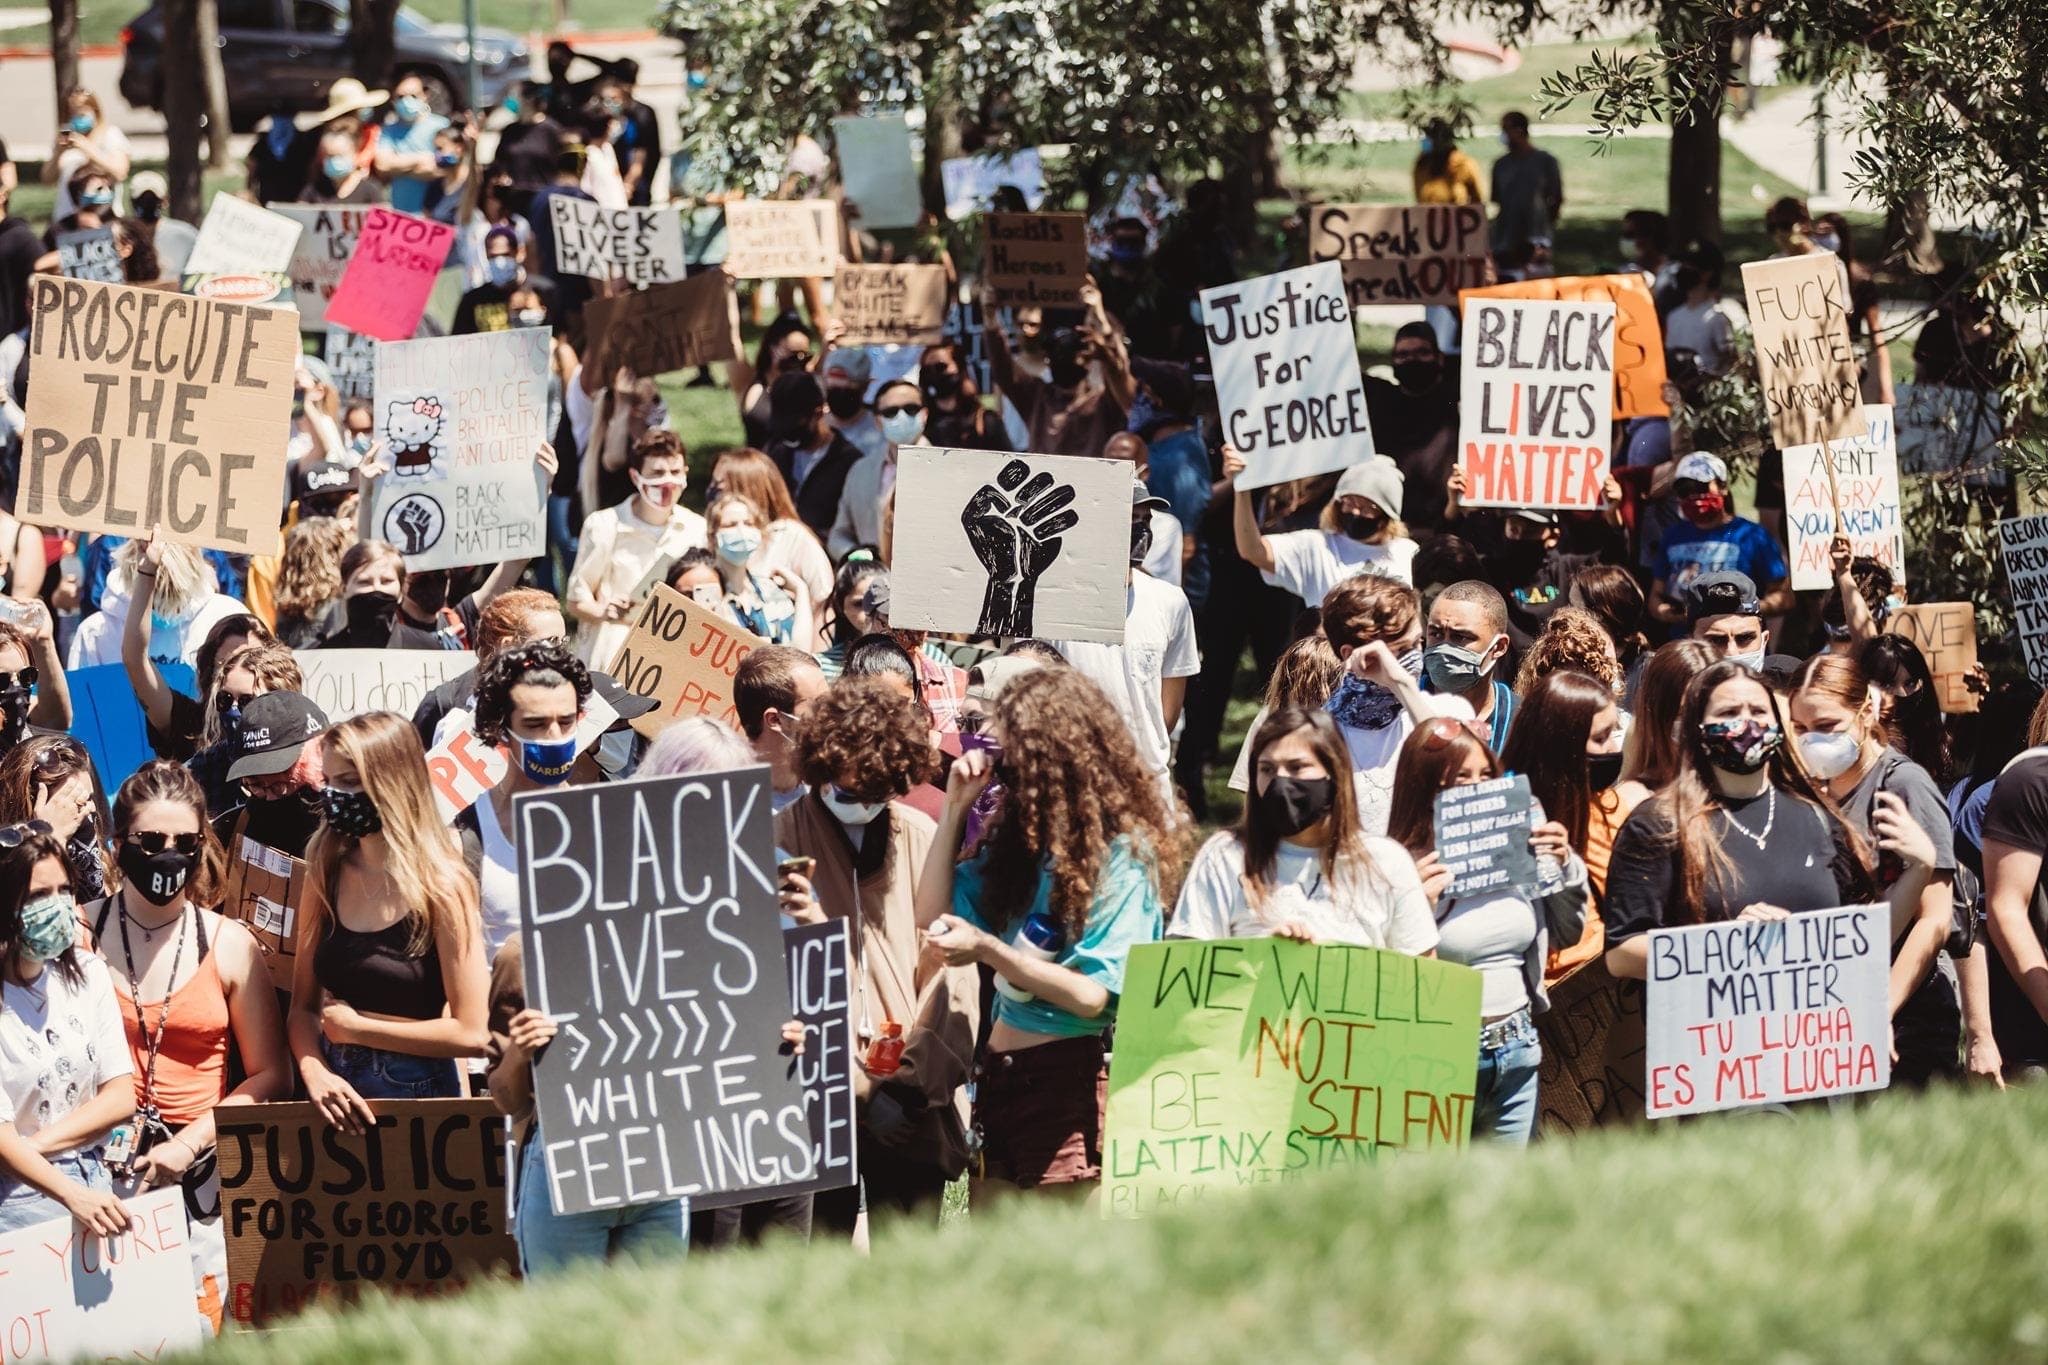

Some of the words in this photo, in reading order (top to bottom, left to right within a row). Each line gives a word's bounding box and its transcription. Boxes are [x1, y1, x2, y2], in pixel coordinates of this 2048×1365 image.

[368, 207, 447, 247] STOP
[555, 200, 657, 233] BLACK
[1314, 207, 1421, 262] Speak
[1425, 206, 1482, 253] UP
[559, 228, 650, 258] LIVES
[562, 250, 669, 279] MATTER
[1206, 281, 1349, 346] Justice
[1756, 274, 1845, 323] FUCK
[34, 279, 273, 389] PROSECUTE
[1476, 307, 1616, 373] BLACK
[1764, 332, 1852, 370] WHITE
[377, 344, 437, 388] HELLO
[1255, 350, 1312, 391] For
[84, 372, 208, 445] THE
[1230, 387, 1367, 453] GEORGE
[1481, 382, 1597, 440] LIVES
[1766, 379, 1859, 417] SUPREMACY
[457, 406, 542, 442] BRUTALITY
[27, 427, 256, 545] POLICE
[456, 481, 505, 510] BLACK
[1465, 442, 1605, 507] MATTER
[1792, 476, 1883, 508] ANGRY
[455, 520, 537, 555] MATTER!
[456, 504, 500, 530] LIVES
[1788, 511, 1830, 545] YOU
[639, 595, 687, 642] NO
[302, 661, 356, 713] You
[612, 647, 662, 698] NO
[1441, 804, 1463, 821] FOR
[1463, 795, 1507, 816] OTHERS
[1442, 822, 1470, 840] DOES
[1470, 816, 1495, 834] NOT
[1495, 810, 1527, 829] MEAN
[523, 779, 776, 926] BLACK
[1469, 832, 1509, 854] RIGHTS
[1466, 873, 1489, 891] NOT
[533, 896, 758, 1023] LIVES
[1652, 922, 1773, 982] BLACK
[1778, 911, 1869, 963] LIVES
[1154, 945, 1244, 1013] WE
[1271, 943, 1453, 1026] WILL
[1706, 962, 1844, 1018] MATTER
[1254, 1016, 1376, 1084] NOT
[1687, 1023, 1734, 1056] TU
[1760, 1006, 1853, 1050] LUCHA
[564, 1054, 762, 1127] WHITE
[1151, 1069, 1223, 1133] BE
[1652, 1064, 1695, 1109] ES
[1714, 1054, 1767, 1102] MI
[1783, 1043, 1877, 1094] LUCHA
[218, 1115, 506, 1196] JUSTICE
[546, 1103, 819, 1214] FEELINGS
[1112, 1129, 1272, 1179] LATINX
[232, 1198, 325, 1240] FOR
[334, 1200, 493, 1239] GEORGE
[303, 1240, 453, 1281] FLOYD
